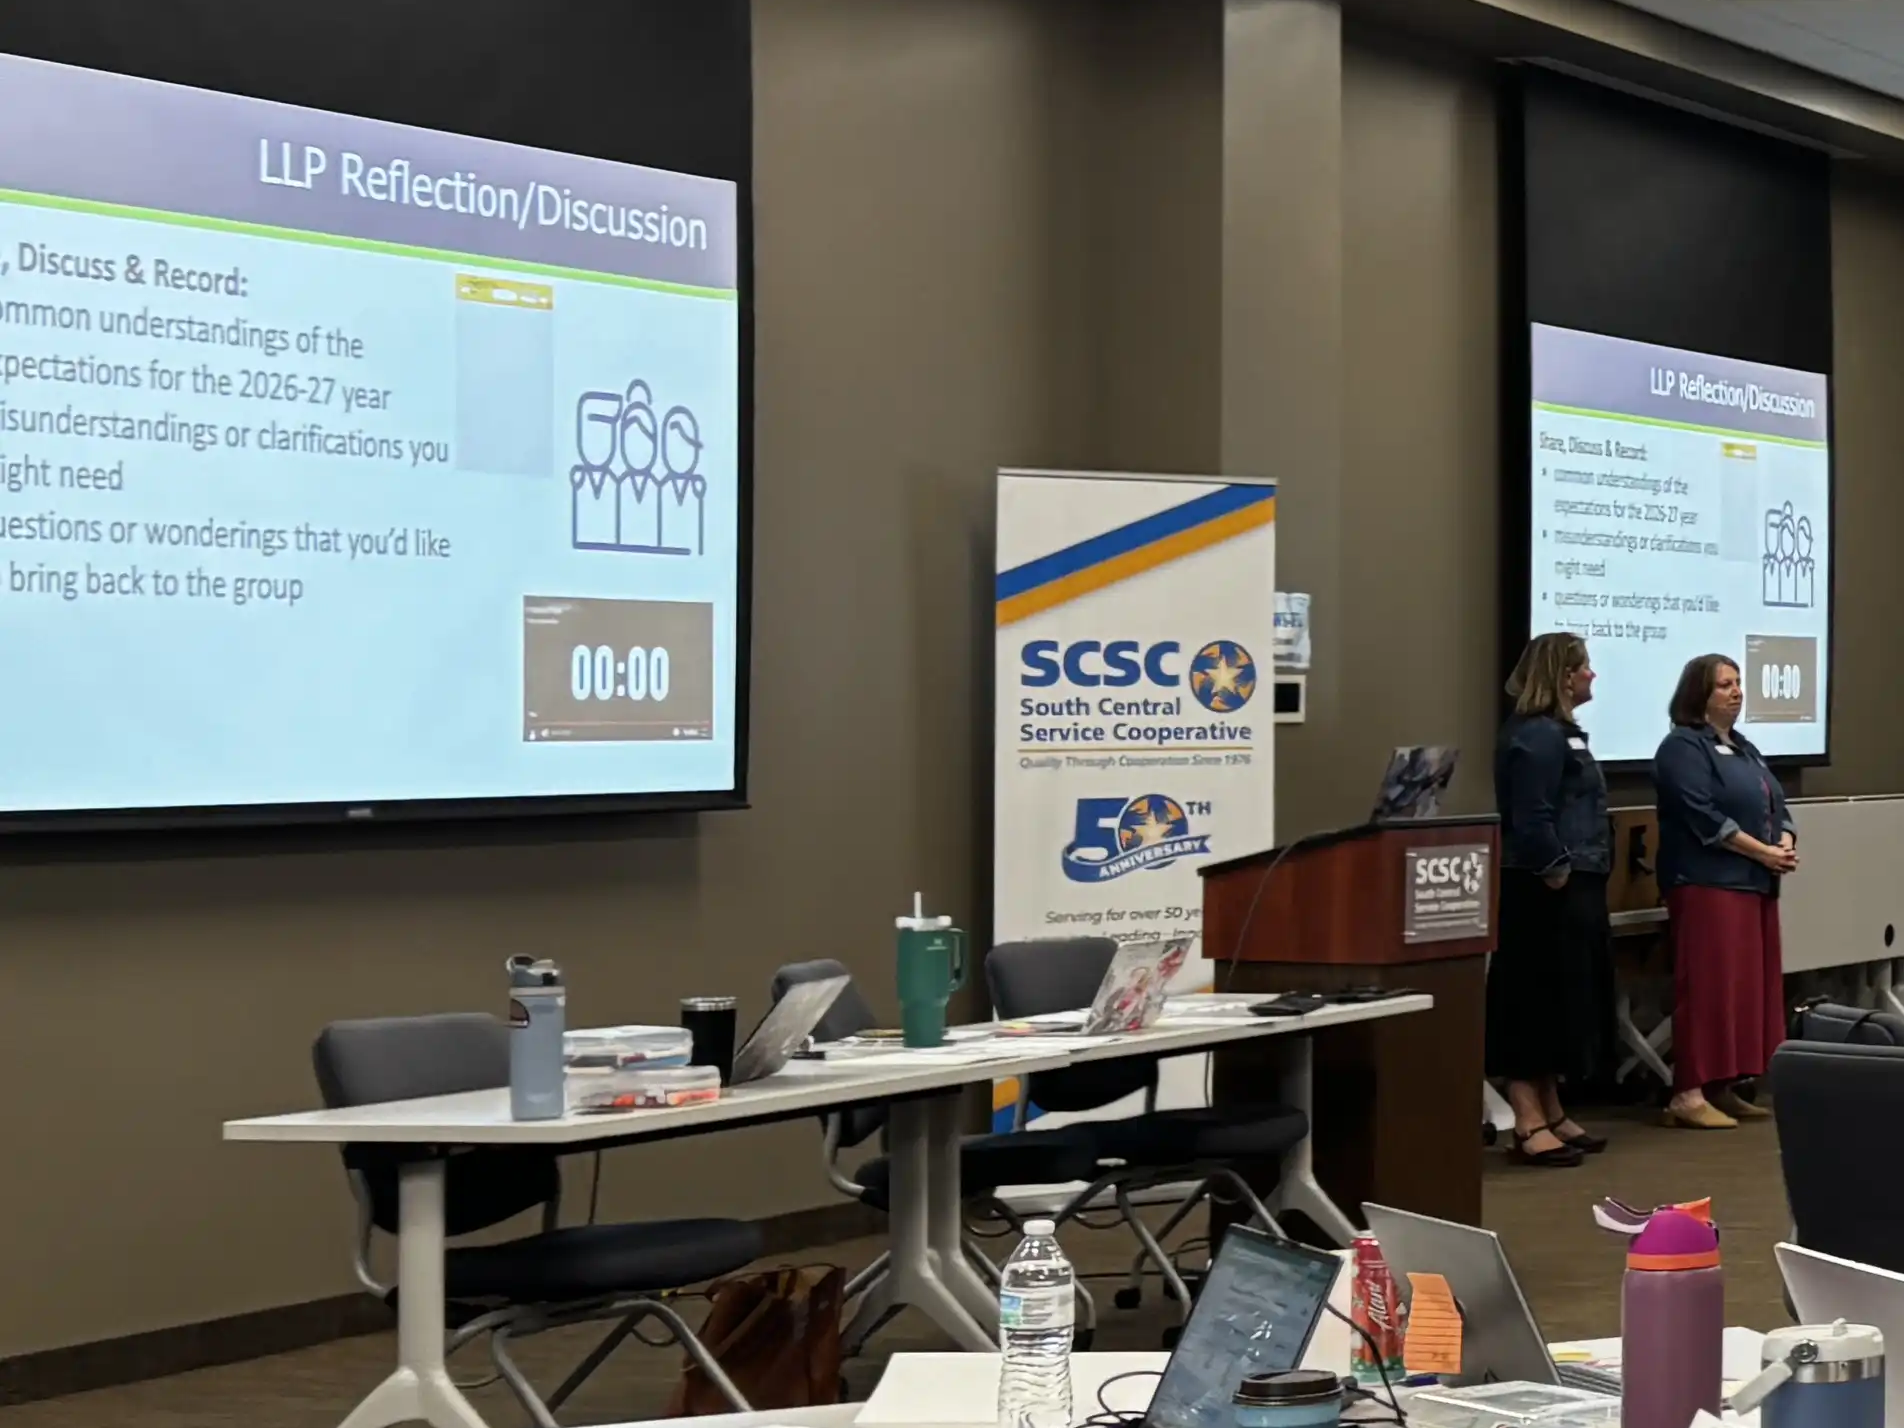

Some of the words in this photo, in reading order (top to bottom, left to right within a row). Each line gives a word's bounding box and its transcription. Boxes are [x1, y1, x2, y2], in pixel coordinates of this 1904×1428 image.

[260, 138, 326, 190] LLP
[341, 152, 708, 251] Reflection/Discussion
[18, 242, 117, 282] Discuss
[124, 254, 147, 285] &
[153, 258, 249, 298] Record:
[99, 307, 291, 357] understandings
[296, 326, 321, 355] of
[326, 328, 364, 360] the
[0, 353, 143, 388] pectations
[150, 359, 185, 392] for
[192, 364, 233, 396] the
[239, 369, 336, 406] 2026-27
[342, 384, 393, 414] year
[1650, 367, 1676, 396] LLP
[1679, 373, 1816, 419] Reflection/Discussion
[0, 400, 218, 452] isunderstandings
[225, 425, 251, 448] or
[257, 420, 404, 461] clarifications
[409, 440, 450, 468] you
[0, 453, 52, 493] ight
[59, 459, 125, 491] need
[109, 521, 139, 545] or
[144, 517, 288, 557] wonderings
[294, 522, 342, 553] that
[414, 528, 452, 558] like
[10, 560, 79, 601] bring
[86, 562, 145, 596] back
[152, 569, 179, 597] to
[186, 566, 227, 598] the
[233, 576, 304, 607] group
[571, 644, 669, 702] 00:00
[1020, 639, 1181, 688] SCSC
[1762, 664, 1801, 700] 00:00
[1020, 697, 1090, 716] South
[1098, 696, 1181, 716] Central
[1020, 723, 1105, 742] Service
[1113, 721, 1252, 745] Cooperative
[1099, 839, 1202, 879] ANNIVERSARY
[1415, 856, 1461, 885] SCSC
[1045, 910, 1102, 926] Serving
[1106, 908, 1124, 922] for
[1130, 909, 1160, 921] over
[1164, 907, 1182, 920] 50
[1185, 908, 1203, 923] ye
[1103, 928, 1161, 943] eading
